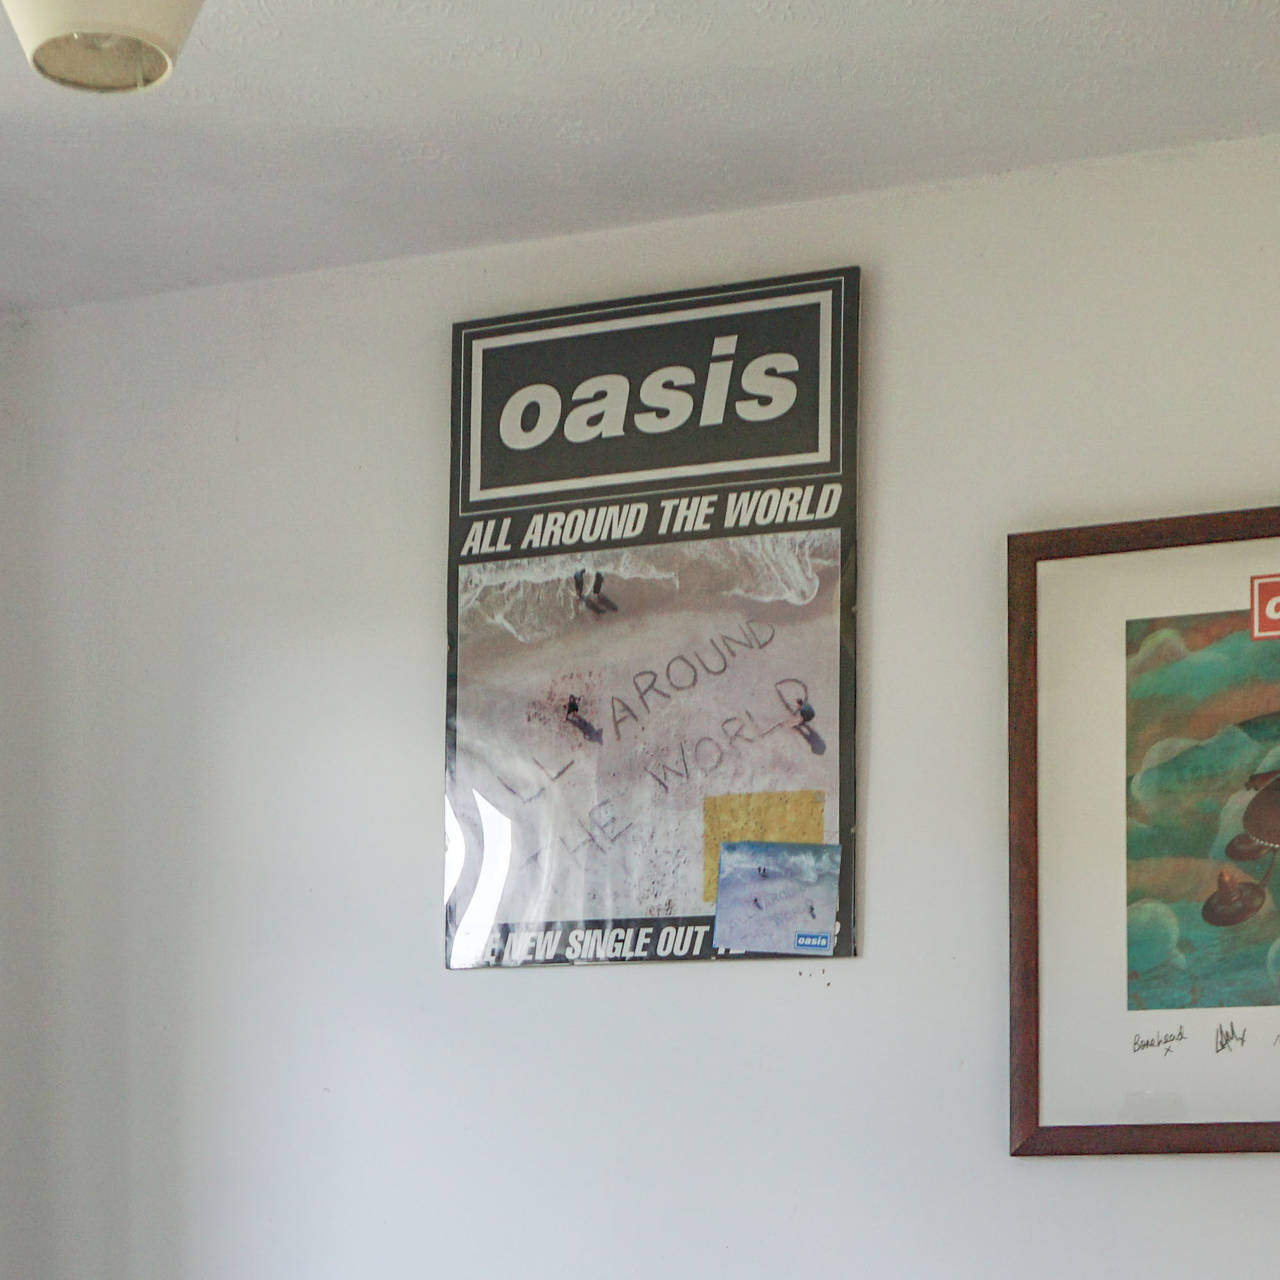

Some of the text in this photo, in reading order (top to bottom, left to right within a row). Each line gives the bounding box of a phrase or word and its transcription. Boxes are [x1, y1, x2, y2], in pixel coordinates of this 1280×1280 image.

[499, 334, 800, 450] oasis
[460, 482, 843, 557] ALL AROUND THE WORLD
[611, 619, 776, 740] AROUND
[644, 678, 816, 792] WORLD
[504, 930, 561, 961] NEW
[566, 927, 653, 960] SINGLE
[657, 926, 711, 956] OUT
[797, 935, 827, 946] oasis
